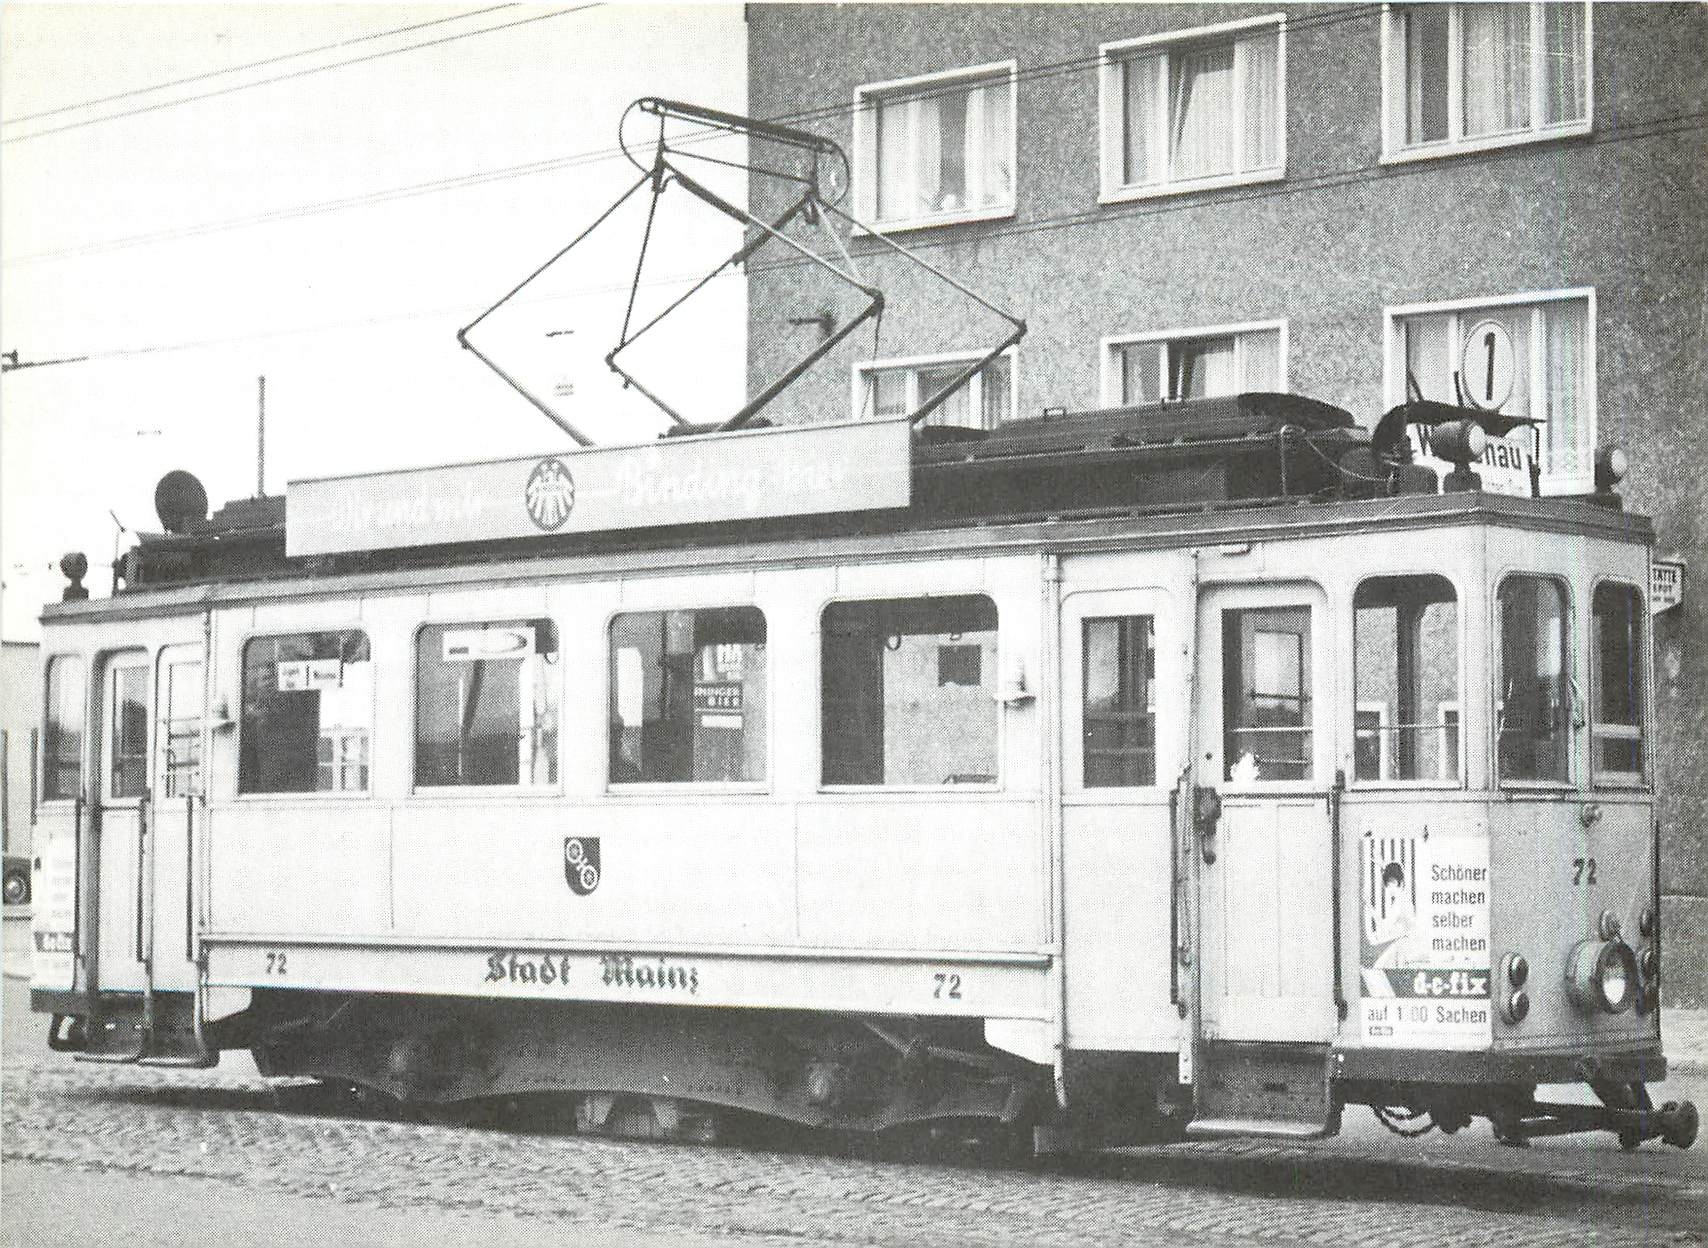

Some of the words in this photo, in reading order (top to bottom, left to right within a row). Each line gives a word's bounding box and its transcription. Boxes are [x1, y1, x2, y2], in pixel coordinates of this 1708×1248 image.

[1484, 332, 1496, 401] 1
[1431, 864, 1486, 881] Schöner
[1573, 858, 1597, 886] 72
[1431, 888, 1486, 905] machen
[1432, 911, 1474, 928] selber
[1432, 936, 1487, 952] machen
[266, 952, 287, 974] 72
[485, 949, 570, 986] Stadt
[600, 953, 699, 995] Mainz
[934, 973, 961, 999] 72
[1367, 1005, 1388, 1021] auf
[1436, 1005, 1487, 1024] Sachen
